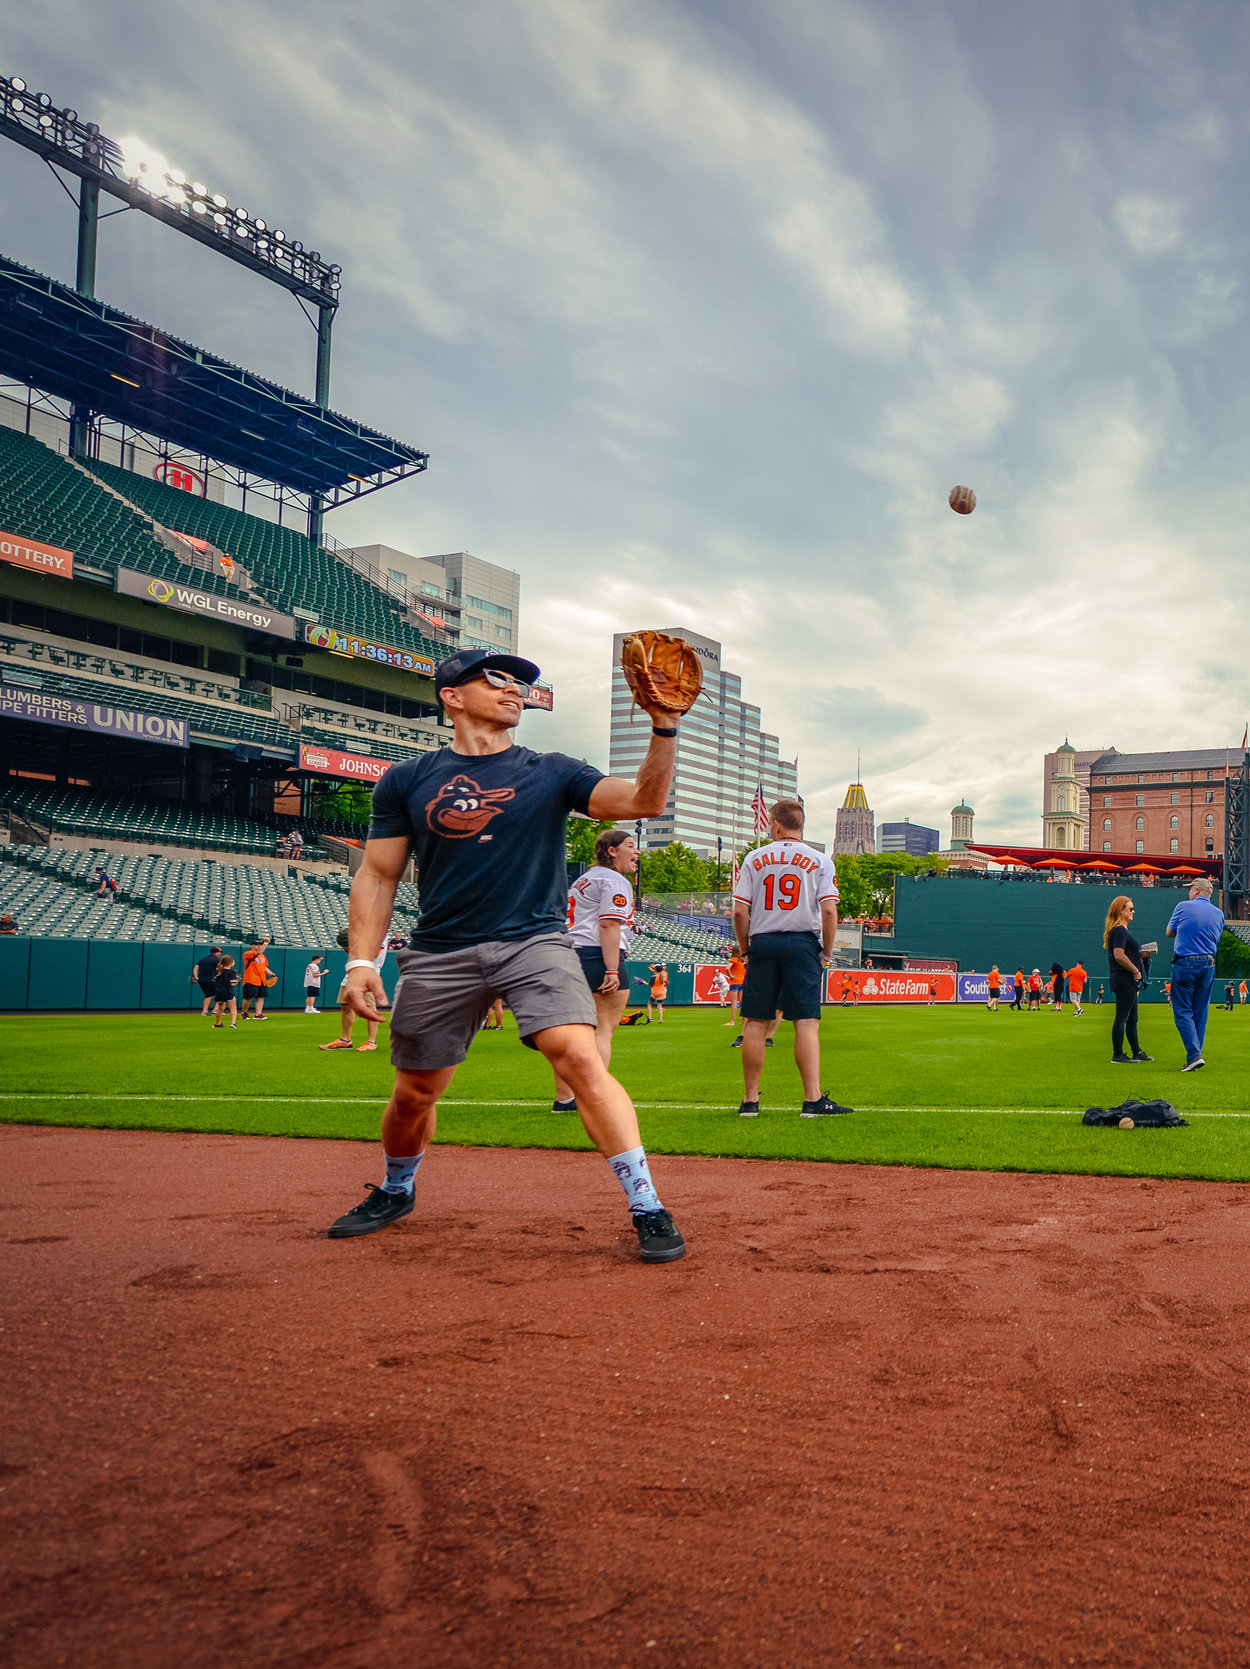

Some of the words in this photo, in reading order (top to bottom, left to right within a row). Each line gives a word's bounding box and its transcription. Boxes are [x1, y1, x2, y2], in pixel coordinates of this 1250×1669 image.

[176, 588, 216, 612] WGL
[217, 600, 272, 629] Energy
[339, 637, 414, 669] 11:36:13
[414, 661, 432, 673] AM
[27, 704, 88, 725] FITTERS
[76, 704, 86, 714] &
[93, 704, 184, 742] UNION
[752, 851, 789, 872] BALL
[790, 852, 820, 874] BOY
[613, 895, 627, 906] 20
[763, 873, 802, 910] 19
[677, 964, 692, 974] 364
